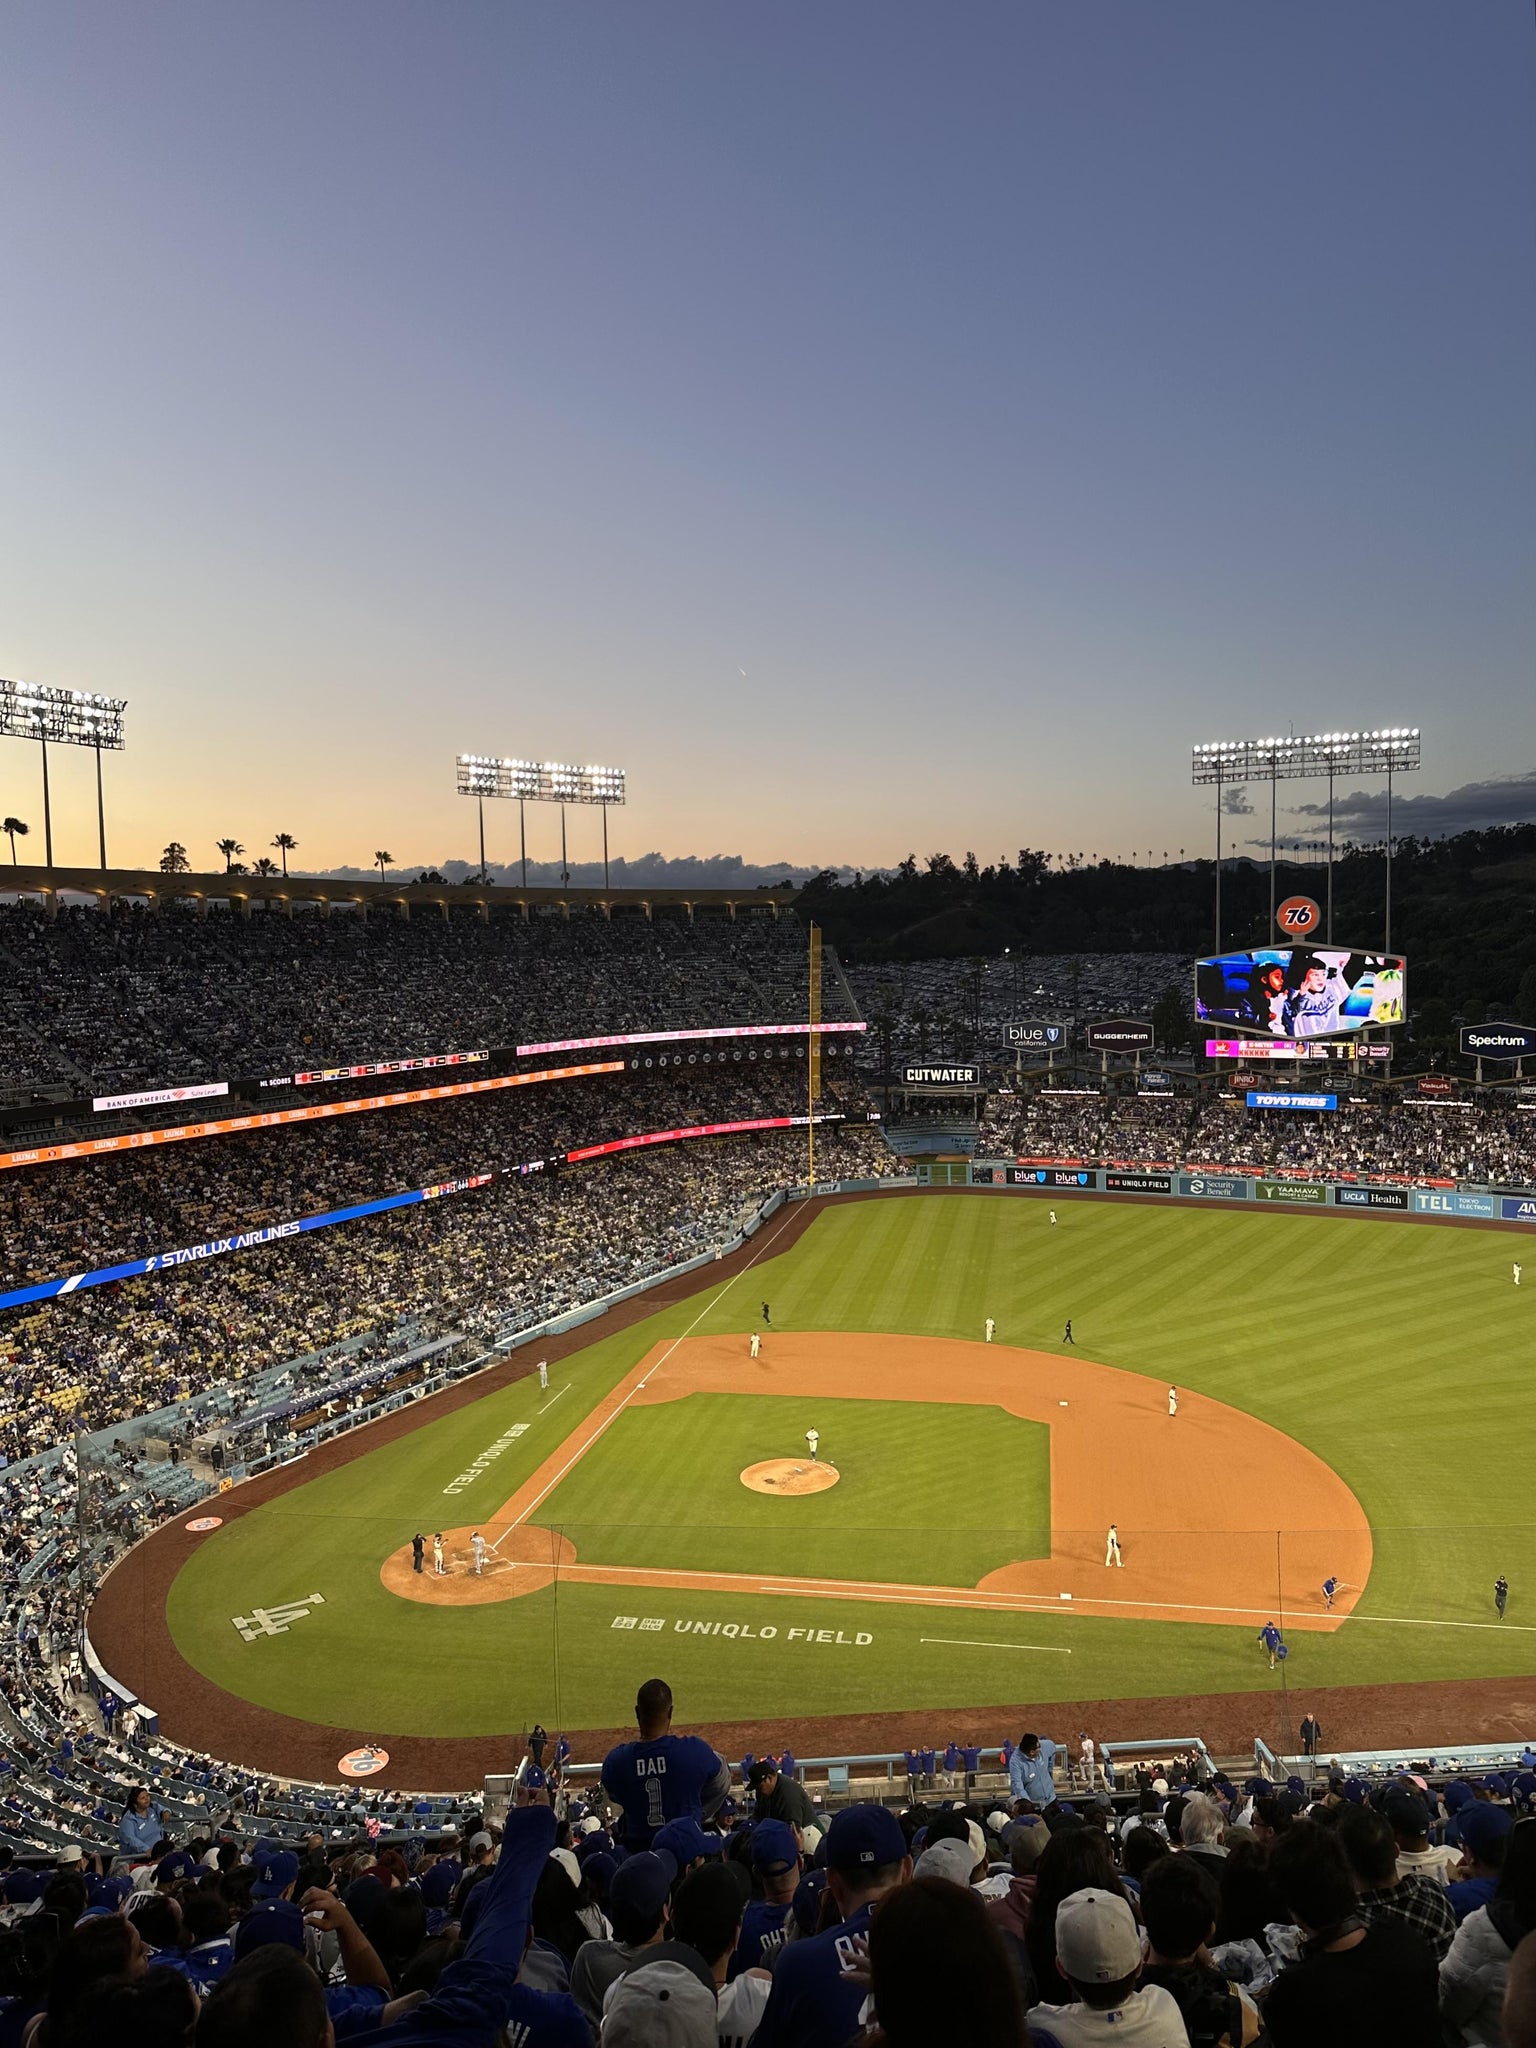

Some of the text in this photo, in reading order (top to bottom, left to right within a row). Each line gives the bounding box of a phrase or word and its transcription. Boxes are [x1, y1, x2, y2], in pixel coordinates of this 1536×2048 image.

[1285, 906, 1312, 926] 76
[1009, 1027, 1042, 1040] blue
[1468, 1035, 1525, 1048] Spectrum
[906, 1069, 973, 1082] CUTWATER
[1233, 1075, 1255, 1085] JINRO
[260, 1077, 292, 1088] NL SCORES
[1420, 1082, 1450, 1090] Yakult
[107, 1094, 171, 1108] BANK OF AMERICA
[1256, 1095, 1327, 1107] TOYO TIRES
[1014, 1171, 1037, 1181] blue
[1055, 1172, 1078, 1182] blue
[1122, 1179, 1169, 1189] UNIQLO FIELD
[1206, 1180, 1236, 1190] Security
[1206, 1187, 1232, 1196] Benefit
[1344, 1192, 1402, 1205] UCLA Health
[1418, 1194, 1453, 1211] TEL
[1458, 1197, 1480, 1205] TOKYO
[1459, 1203, 1491, 1212] ELECTRON
[162, 1221, 300, 1267] STARLUX AIRLINES
[442, 1438, 516, 1494] UNIQLO FIELD
[673, 1620, 874, 1646] UNIQLO FIELD
[636, 1756, 667, 1777] DAD
[644, 1778, 666, 1828] 1
[264, 1865, 273, 1881] LA
